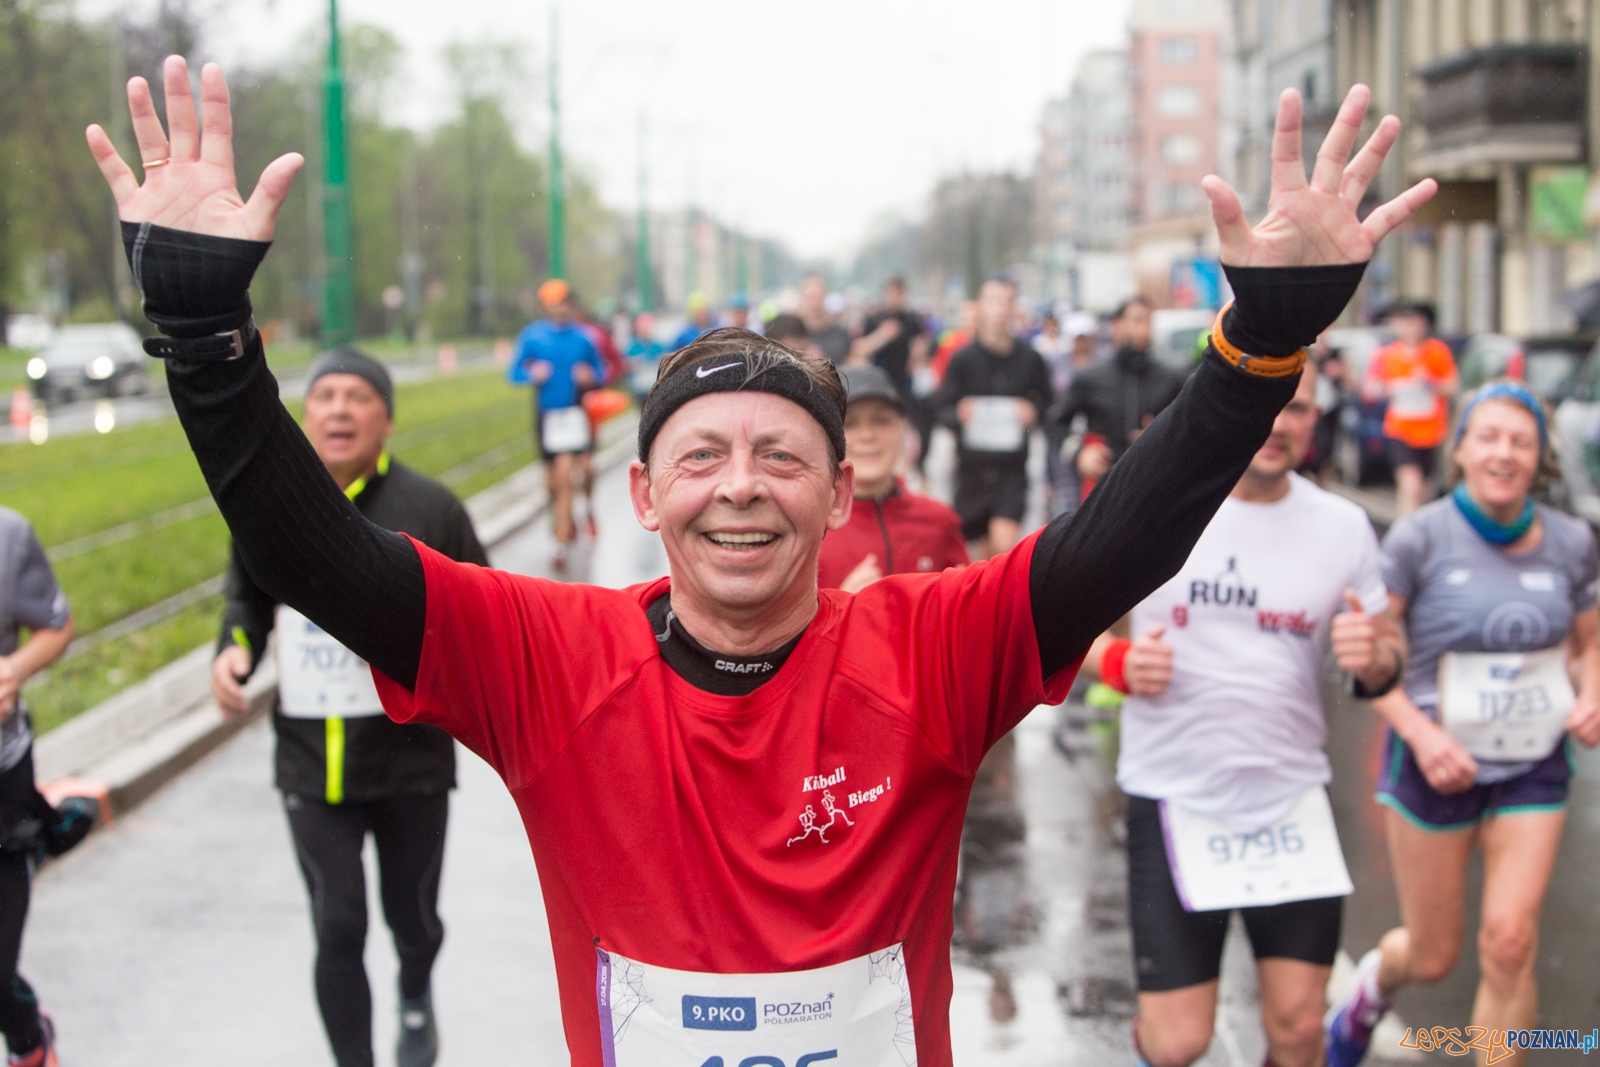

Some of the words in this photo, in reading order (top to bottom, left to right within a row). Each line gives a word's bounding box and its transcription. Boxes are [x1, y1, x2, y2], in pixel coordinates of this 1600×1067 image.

[1189, 579, 1258, 608] RUN
[298, 643, 369, 672] 707
[715, 659, 762, 673] CRAFT
[848, 784, 884, 808] Biega
[1208, 824, 1304, 864] 9796
[708, 1006, 745, 1022] PKO
[764, 1012, 832, 1025] PÓŁMARATON
